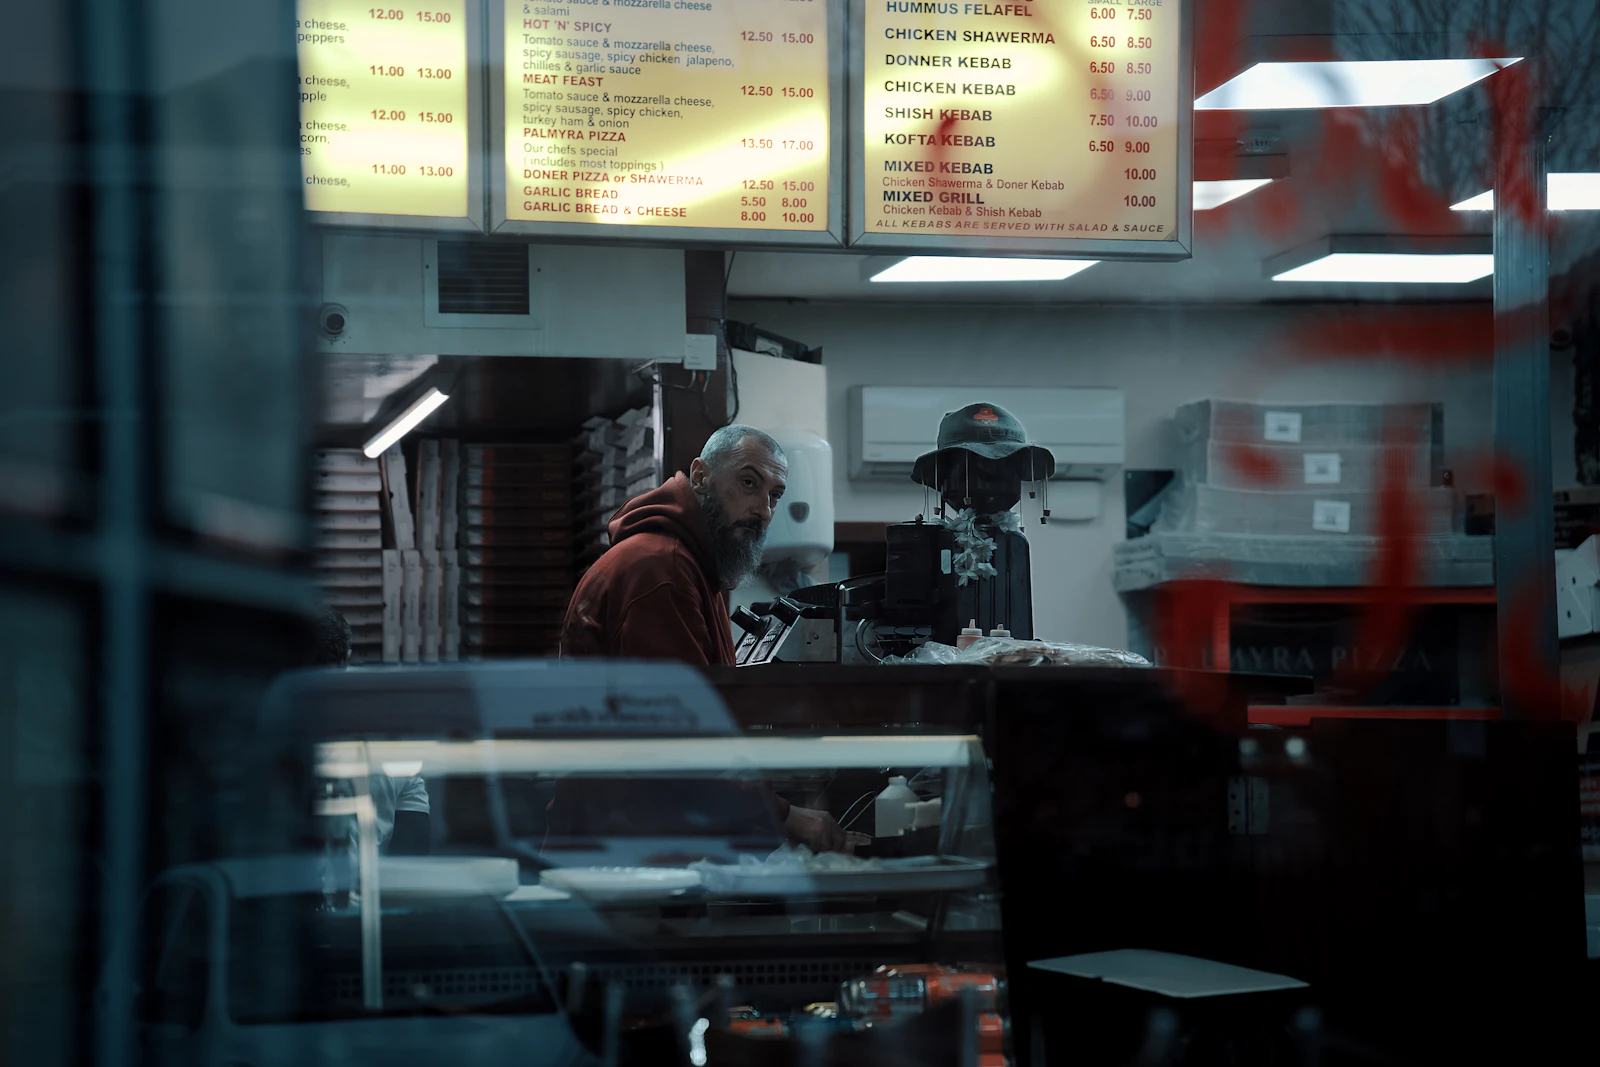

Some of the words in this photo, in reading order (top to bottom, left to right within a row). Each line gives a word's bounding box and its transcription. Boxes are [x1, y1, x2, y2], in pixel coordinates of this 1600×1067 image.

[523, 4, 530, 14] &
[534, 6, 570, 16] salami
[614, 0, 670, 8] mozzarella
[674, 0, 712, 11] cheese
[886, 1, 958, 14] HUMMUS
[964, 4, 1032, 17] FELAFEL
[368, 8, 404, 20] 12.00
[416, 12, 451, 23] 15.00
[1090, 8, 1115, 19] 6.00
[1127, 9, 1152, 20] 7.50
[304, 19, 349, 32] cheese,
[523, 18, 549, 29] HOT
[574, 22, 612, 33] SPICY
[298, 32, 344, 44] peppers
[740, 31, 773, 42] 12.50
[782, 33, 814, 43] 15.00
[885, 28, 957, 41] CHICKEN
[963, 30, 1056, 44] SHAWERMA
[1090, 36, 1115, 48] 6.50
[1127, 37, 1152, 49] 8.50
[523, 34, 563, 46] Tomato
[566, 39, 598, 47] sauce
[602, 38, 610, 48] &
[614, 41, 670, 51] mozzarella
[674, 42, 715, 54] cheese,
[523, 48, 552, 60] spicy
[555, 52, 603, 62] sausage,
[607, 53, 635, 64] spicy
[640, 53, 680, 64] chicken
[886, 54, 952, 67] DONNER
[958, 56, 1012, 69] KEBAB
[370, 66, 404, 76] 11.00
[417, 68, 452, 79] 13.00
[523, 60, 560, 71] chillies
[565, 62, 572, 72] &
[576, 62, 606, 74] garlic
[609, 66, 641, 74] sauce
[1090, 62, 1115, 74] 6.50
[1127, 63, 1151, 74] 8.50
[306, 76, 350, 88] cheese,
[523, 74, 558, 85] MEAT
[563, 76, 604, 86] FEAST
[741, 86, 773, 96] 12.50
[782, 87, 814, 98] 15.00
[884, 81, 956, 94] CHICKEN
[962, 83, 1016, 96] KEBAB
[1090, 89, 1114, 100] 6.50
[1126, 90, 1151, 101] 9.00
[298, 91, 327, 102] pple
[523, 89, 563, 100] Tomato
[566, 93, 598, 102] sauce
[603, 92, 610, 102] &
[614, 94, 670, 105] mozzarella
[674, 96, 714, 108] cheese,
[371, 110, 405, 121] 12.00
[418, 112, 453, 123] 15.00
[523, 102, 552, 115] spicy
[555, 106, 603, 117] sausage,
[607, 107, 635, 118] spicy
[639, 106, 683, 119] chicken,
[885, 107, 933, 120] SHISH
[939, 109, 993, 121] KEBAB
[306, 120, 350, 132] cheese,
[523, 115, 557, 127] turkey
[561, 116, 584, 127] ham
[588, 117, 595, 127] &
[599, 118, 629, 128] onion
[1089, 115, 1114, 126] 7.50
[1126, 116, 1158, 127] 10.00
[524, 128, 584, 140] PALMYRA
[589, 131, 626, 142] PIZZA
[885, 134, 936, 146] KOFTA
[941, 135, 995, 147] KEBAB
[524, 143, 543, 153] Our
[547, 144, 576, 155] chefs
[580, 146, 618, 157] special
[741, 138, 773, 149] 13.50
[782, 140, 813, 151] 17.00
[1089, 141, 1114, 152] 6.50
[1125, 142, 1150, 153] 9.00
[372, 164, 406, 175] 11.00
[419, 166, 453, 177] 13.00
[530, 158, 576, 168] includes
[580, 160, 606, 169] most
[610, 161, 657, 172] toppings
[884, 160, 935, 173] MIXED
[939, 162, 994, 174] KEBAB
[306, 175, 350, 187] cheese,
[524, 169, 568, 180] DONER
[573, 171, 609, 182] PIZZA
[614, 175, 626, 183] or
[630, 174, 704, 186] SHAWERMA
[1124, 169, 1156, 180] 10.00
[742, 180, 774, 190] 12.50
[782, 181, 814, 192] 15.00
[882, 177, 924, 187] Chicken
[928, 178, 982, 188] Shawerma
[986, 179, 993, 189] &
[997, 179, 1028, 189] Doner
[1031, 180, 1064, 190] Kebab
[524, 186, 571, 197] GARLIC
[576, 188, 618, 199] BREAD
[883, 191, 933, 202] MIXED
[939, 192, 985, 204] GRILL
[741, 197, 766, 207] 5.50
[782, 198, 807, 208] 8.00
[1124, 196, 1156, 207] 10.00
[524, 201, 571, 213] GARLIC
[576, 204, 618, 215] BREAD
[624, 206, 632, 215] &
[637, 206, 687, 218] CHEESE
[883, 205, 925, 215] Chicken
[929, 205, 962, 216] Kebab
[965, 207, 973, 216] &
[976, 207, 1006, 217] Shish
[1009, 207, 1042, 218] Kebab
[741, 212, 766, 221] 8.00
[782, 213, 814, 223] 10.00
[876, 220, 898, 228] ALL
[903, 220, 952, 228] KEBABS
[955, 221, 979, 229] ARE
[984, 222, 1030, 230] SERVED
[1035, 223, 1064, 231] WITH
[1068, 223, 1108, 232] SALAD
[1112, 224, 1119, 232] &
[1123, 224, 1164, 233] SAUCE
[1152, 646, 1314, 671] PLYRA
[1332, 646, 1432, 672] PIZZA
